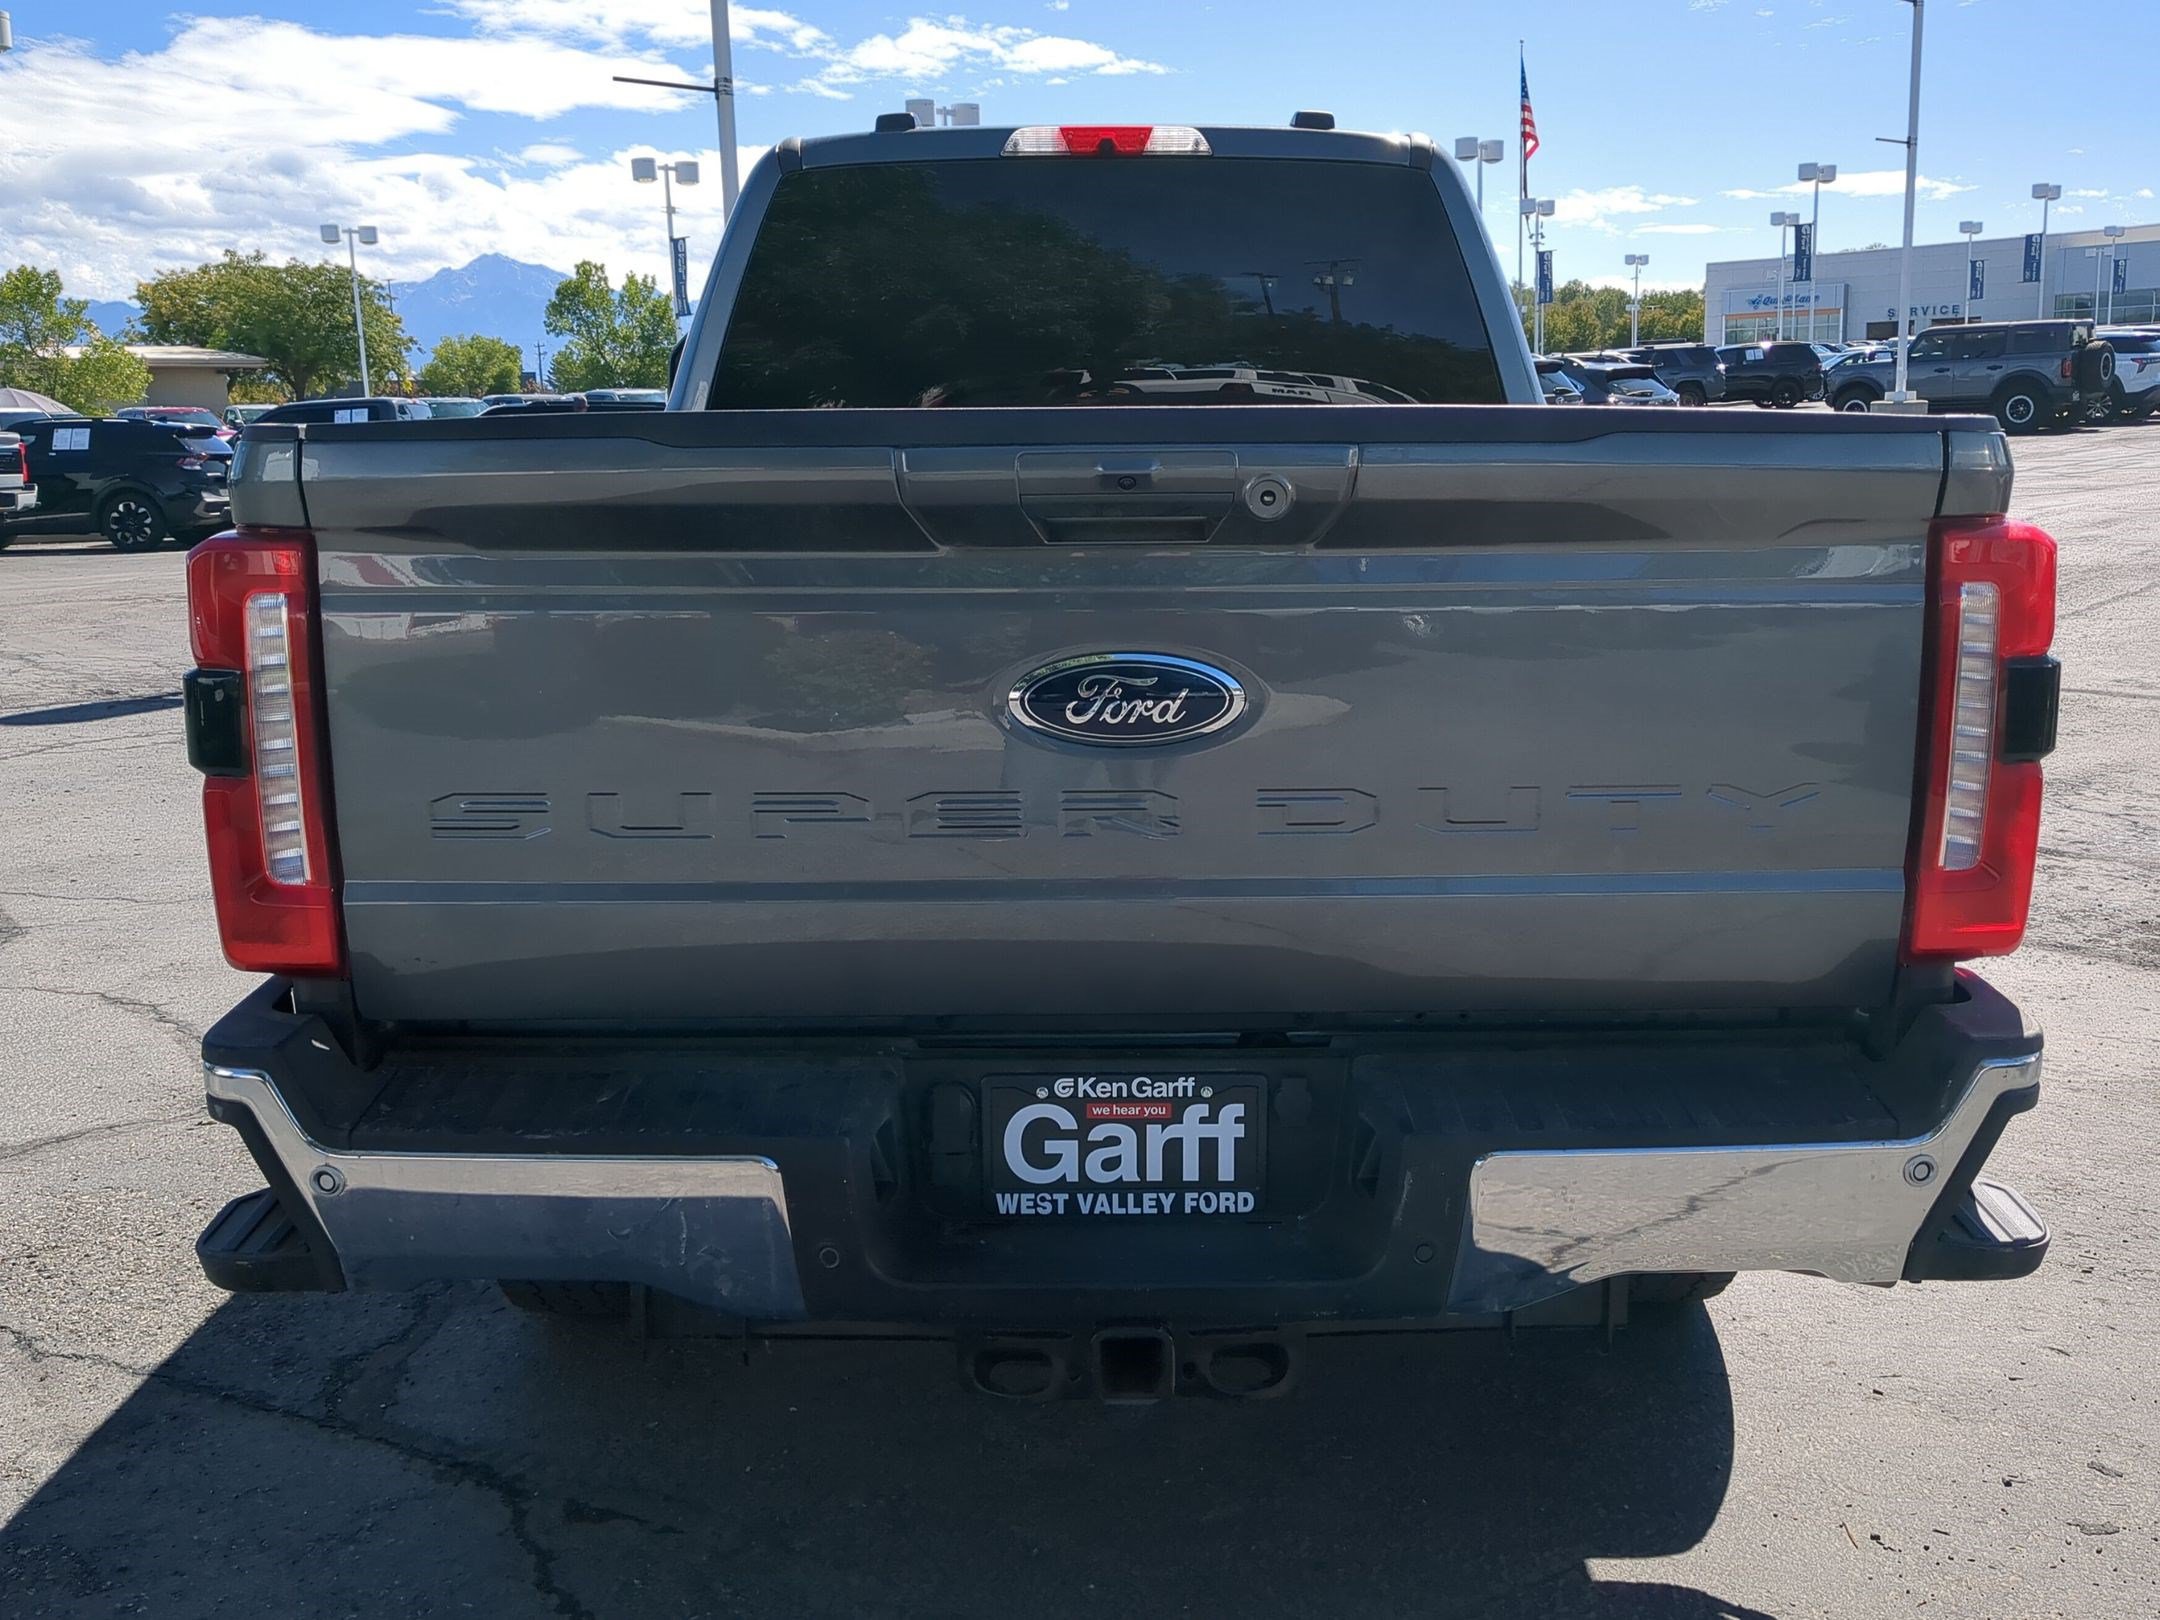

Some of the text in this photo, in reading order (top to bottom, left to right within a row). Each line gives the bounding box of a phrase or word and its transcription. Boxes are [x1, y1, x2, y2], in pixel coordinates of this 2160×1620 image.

[1763, 295, 1792, 305] Quik
[1887, 304, 1960, 318] SRVICE
[1065, 674, 1189, 724] Ford
[430, 782, 1821, 840] SUPER DUTY
[1078, 1076, 1196, 1098] Ken Garff
[1092, 1104, 1166, 1118] we hear you
[1003, 1103, 1245, 1184] Garff
[996, 1191, 1255, 1215] WEST VALLEY FORD
